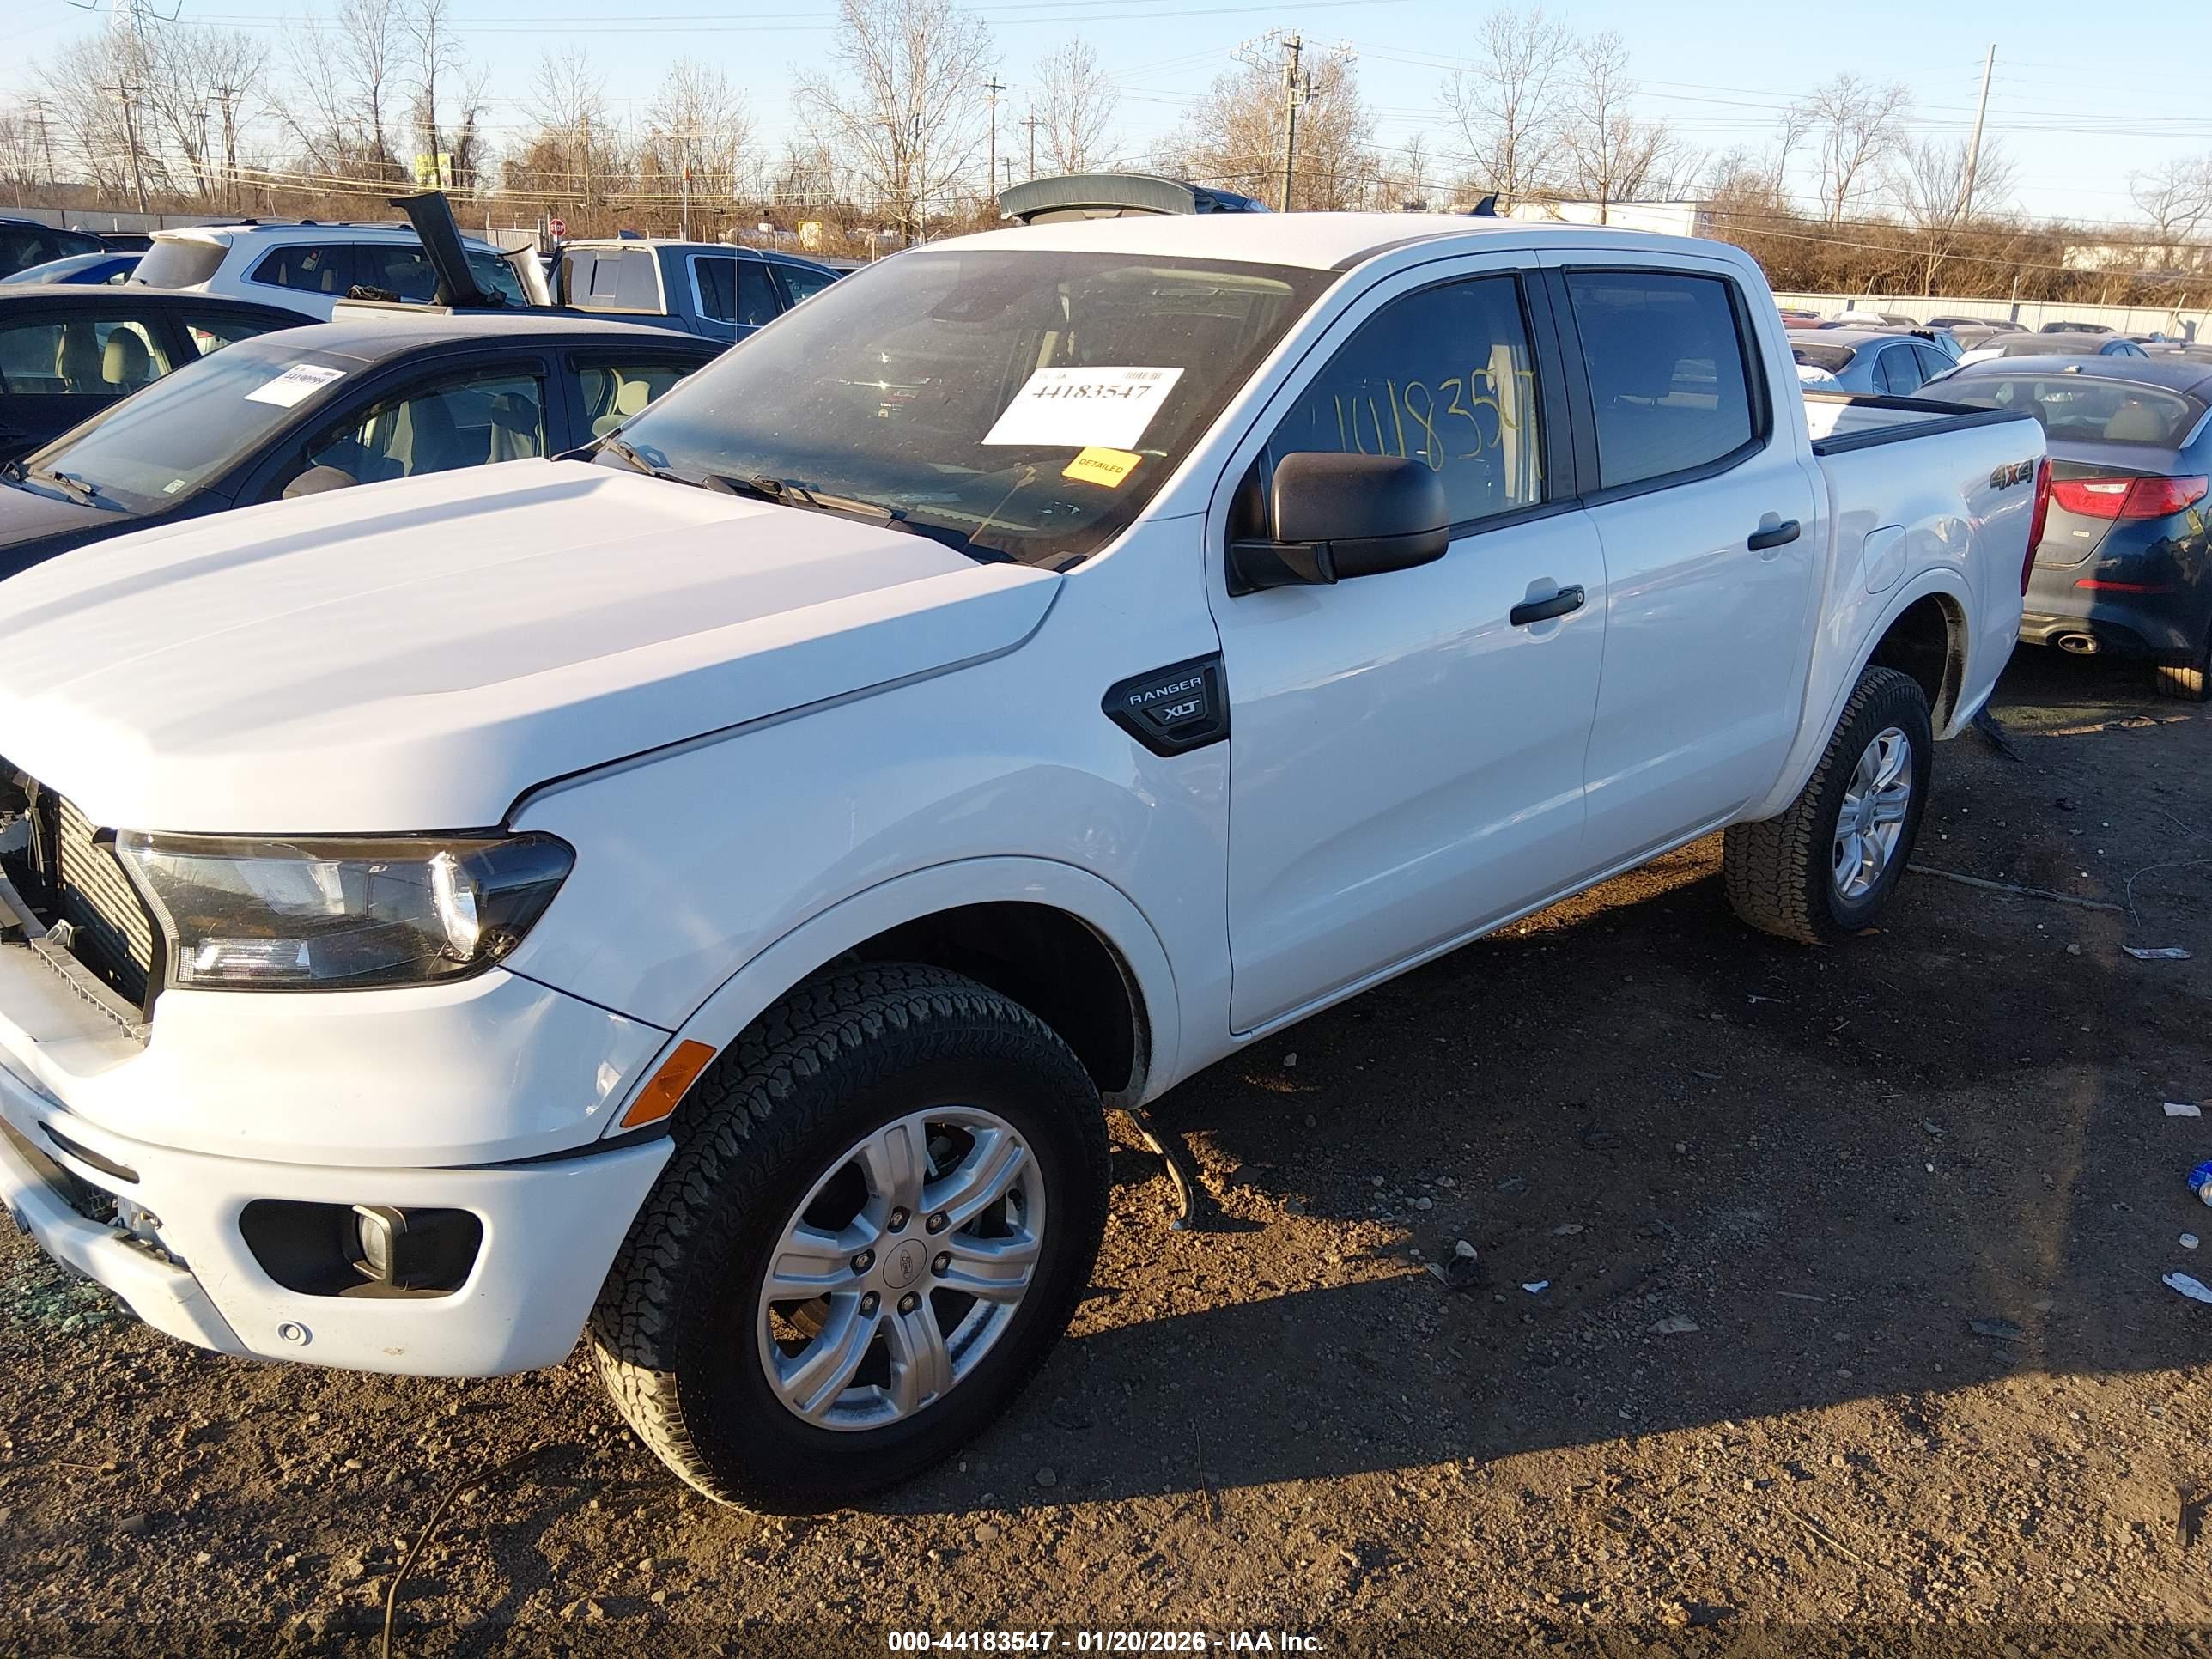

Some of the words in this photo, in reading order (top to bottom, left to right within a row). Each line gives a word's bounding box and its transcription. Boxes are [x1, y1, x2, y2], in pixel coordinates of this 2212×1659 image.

[1031, 384, 1152, 399] 44183547
[1079, 458, 1124, 474] DETAILED
[1129, 677, 1202, 706] RANGER
[1162, 699, 1200, 720] XLT
